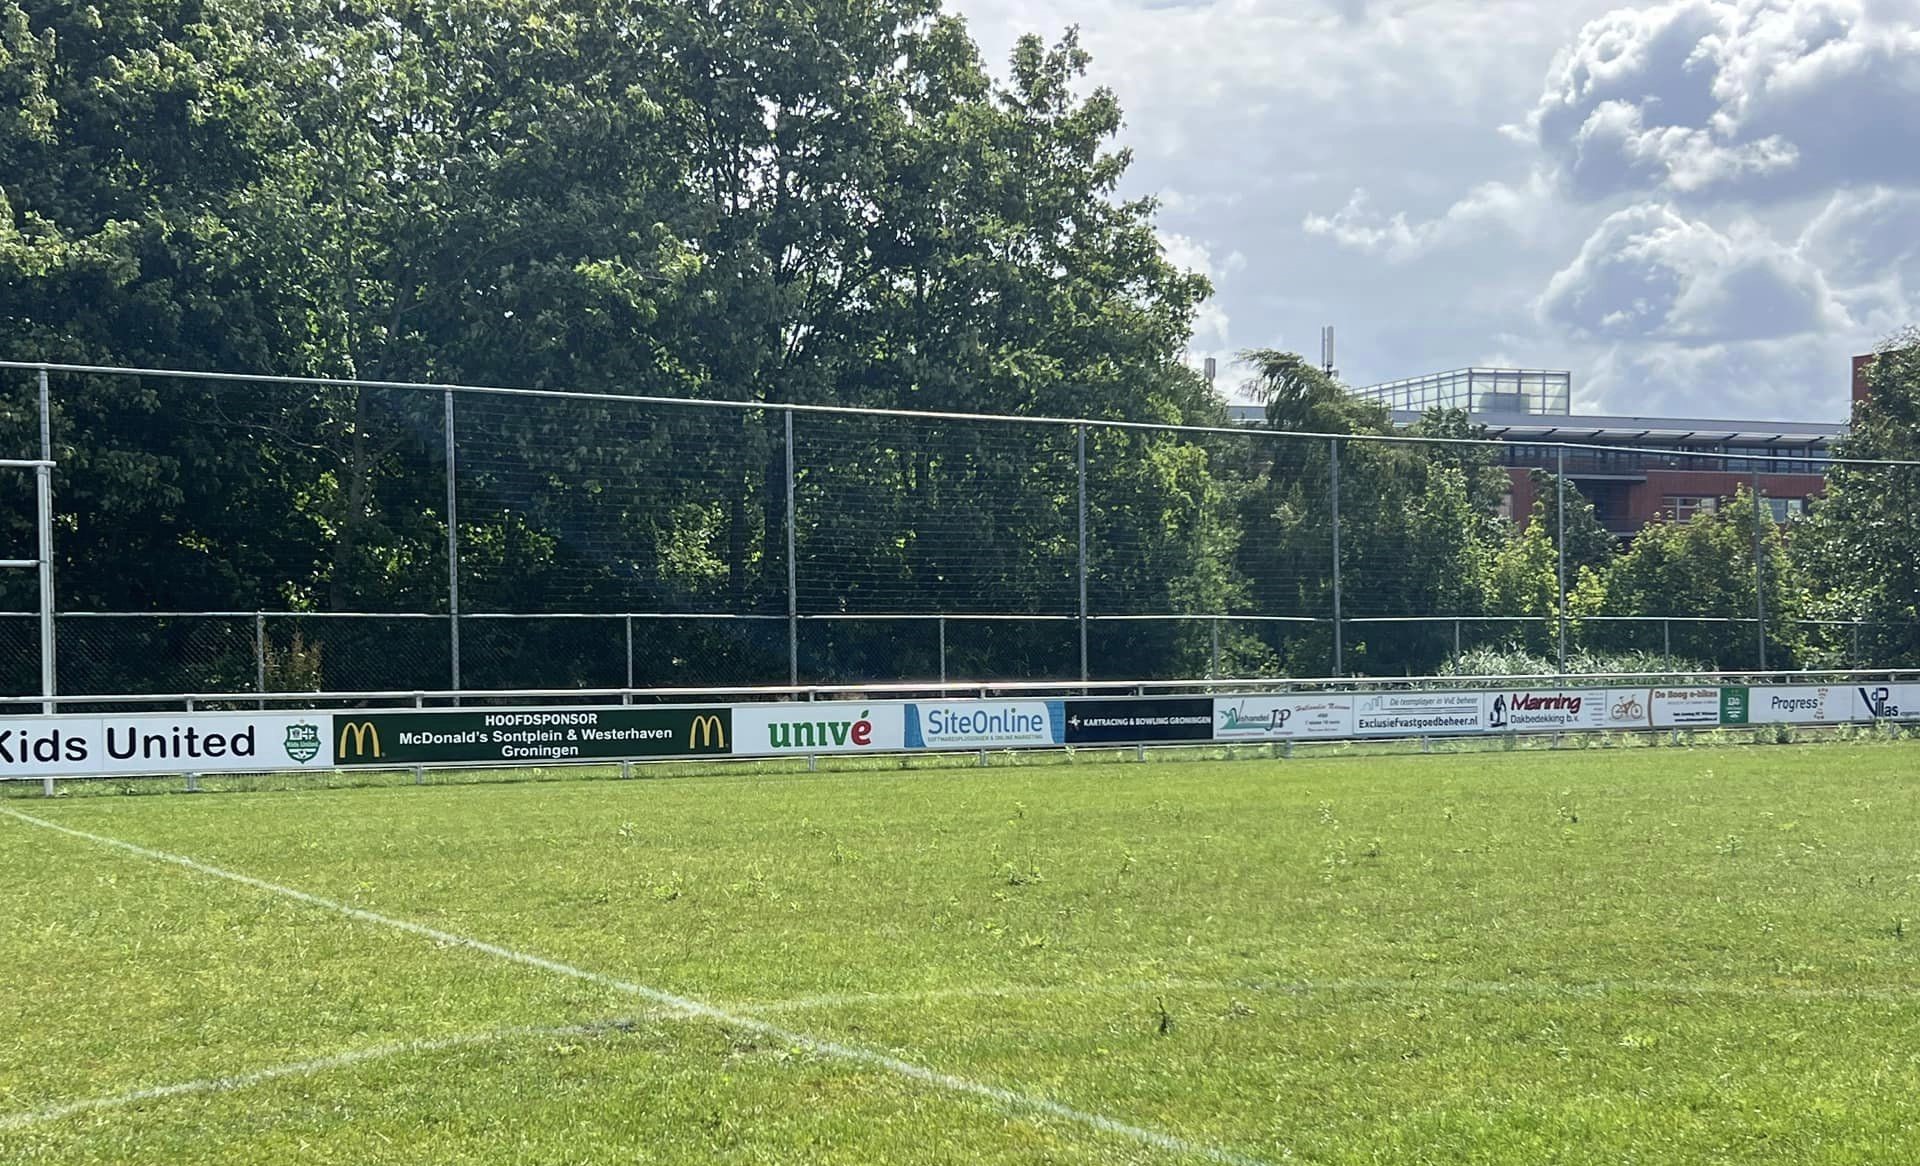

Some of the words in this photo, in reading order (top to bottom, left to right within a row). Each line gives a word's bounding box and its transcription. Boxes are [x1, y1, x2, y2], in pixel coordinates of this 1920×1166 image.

[1511, 693, 1581, 714] Manning
[1771, 696, 1818, 712] Progress
[485, 713, 598, 726] HOOFDSPONSOR
[928, 707, 1043, 734] SiteOnline
[1083, 718, 1129, 727] KARTRACING
[1136, 717, 1168, 726] BOWLING
[1169, 716, 1212, 725] GRONINGEN
[1359, 716, 1478, 729] Exclusiefvastgoedbeheer.nl
[1511, 714, 1564, 724] Dakbedekking
[399, 731, 489, 744] McDonald's
[492, 729, 562, 744] Sontplein
[566, 729, 578, 741] &
[581, 727, 673, 740] Westerhaven
[768, 709, 872, 748] univé
[106, 724, 256, 760] United
[501, 745, 579, 759] Groningen
